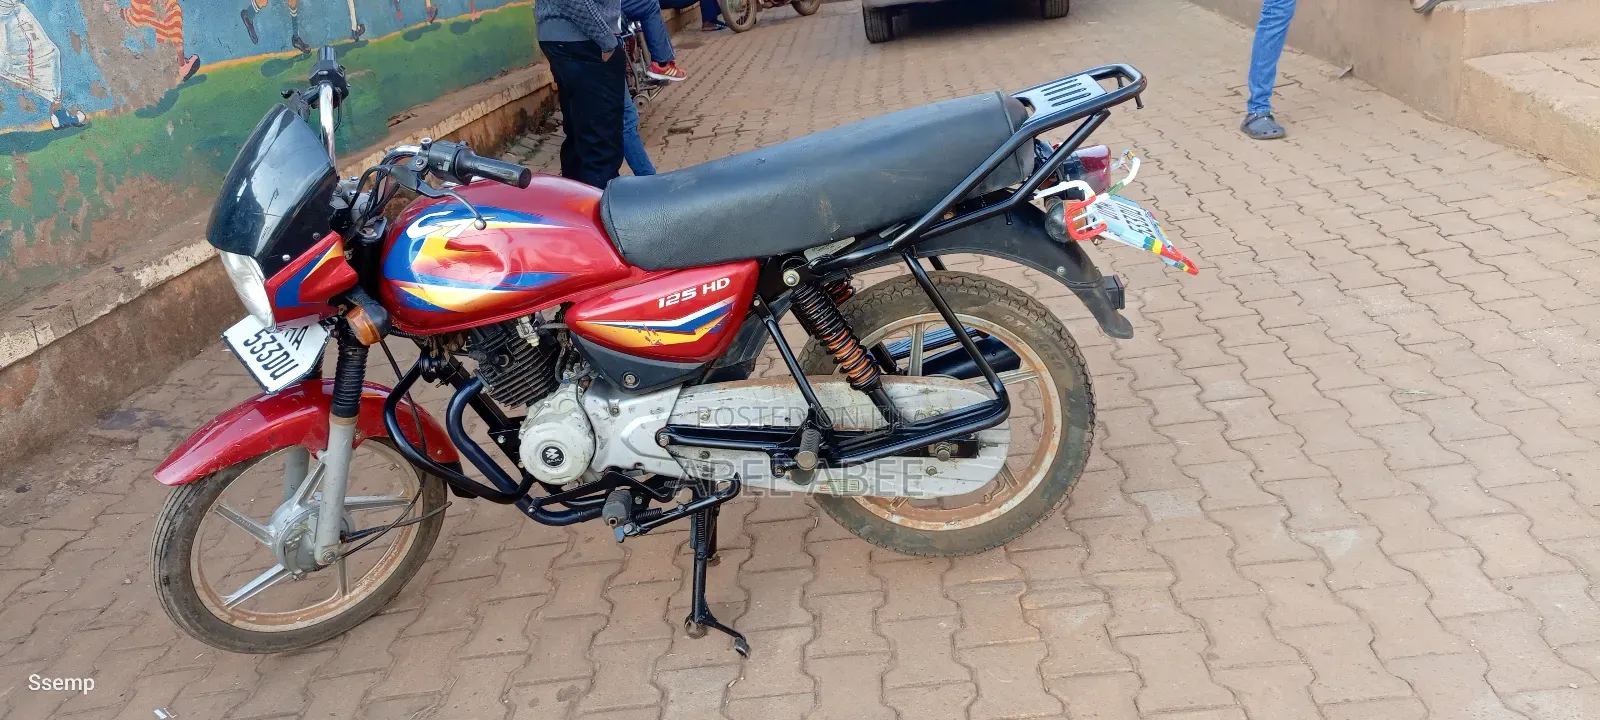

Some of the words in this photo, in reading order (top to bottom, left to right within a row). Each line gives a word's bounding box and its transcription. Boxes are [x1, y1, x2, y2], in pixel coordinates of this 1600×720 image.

[656, 287, 698, 309] 125
[702, 277, 731, 295] HD
[242, 328, 300, 381] 533DU
